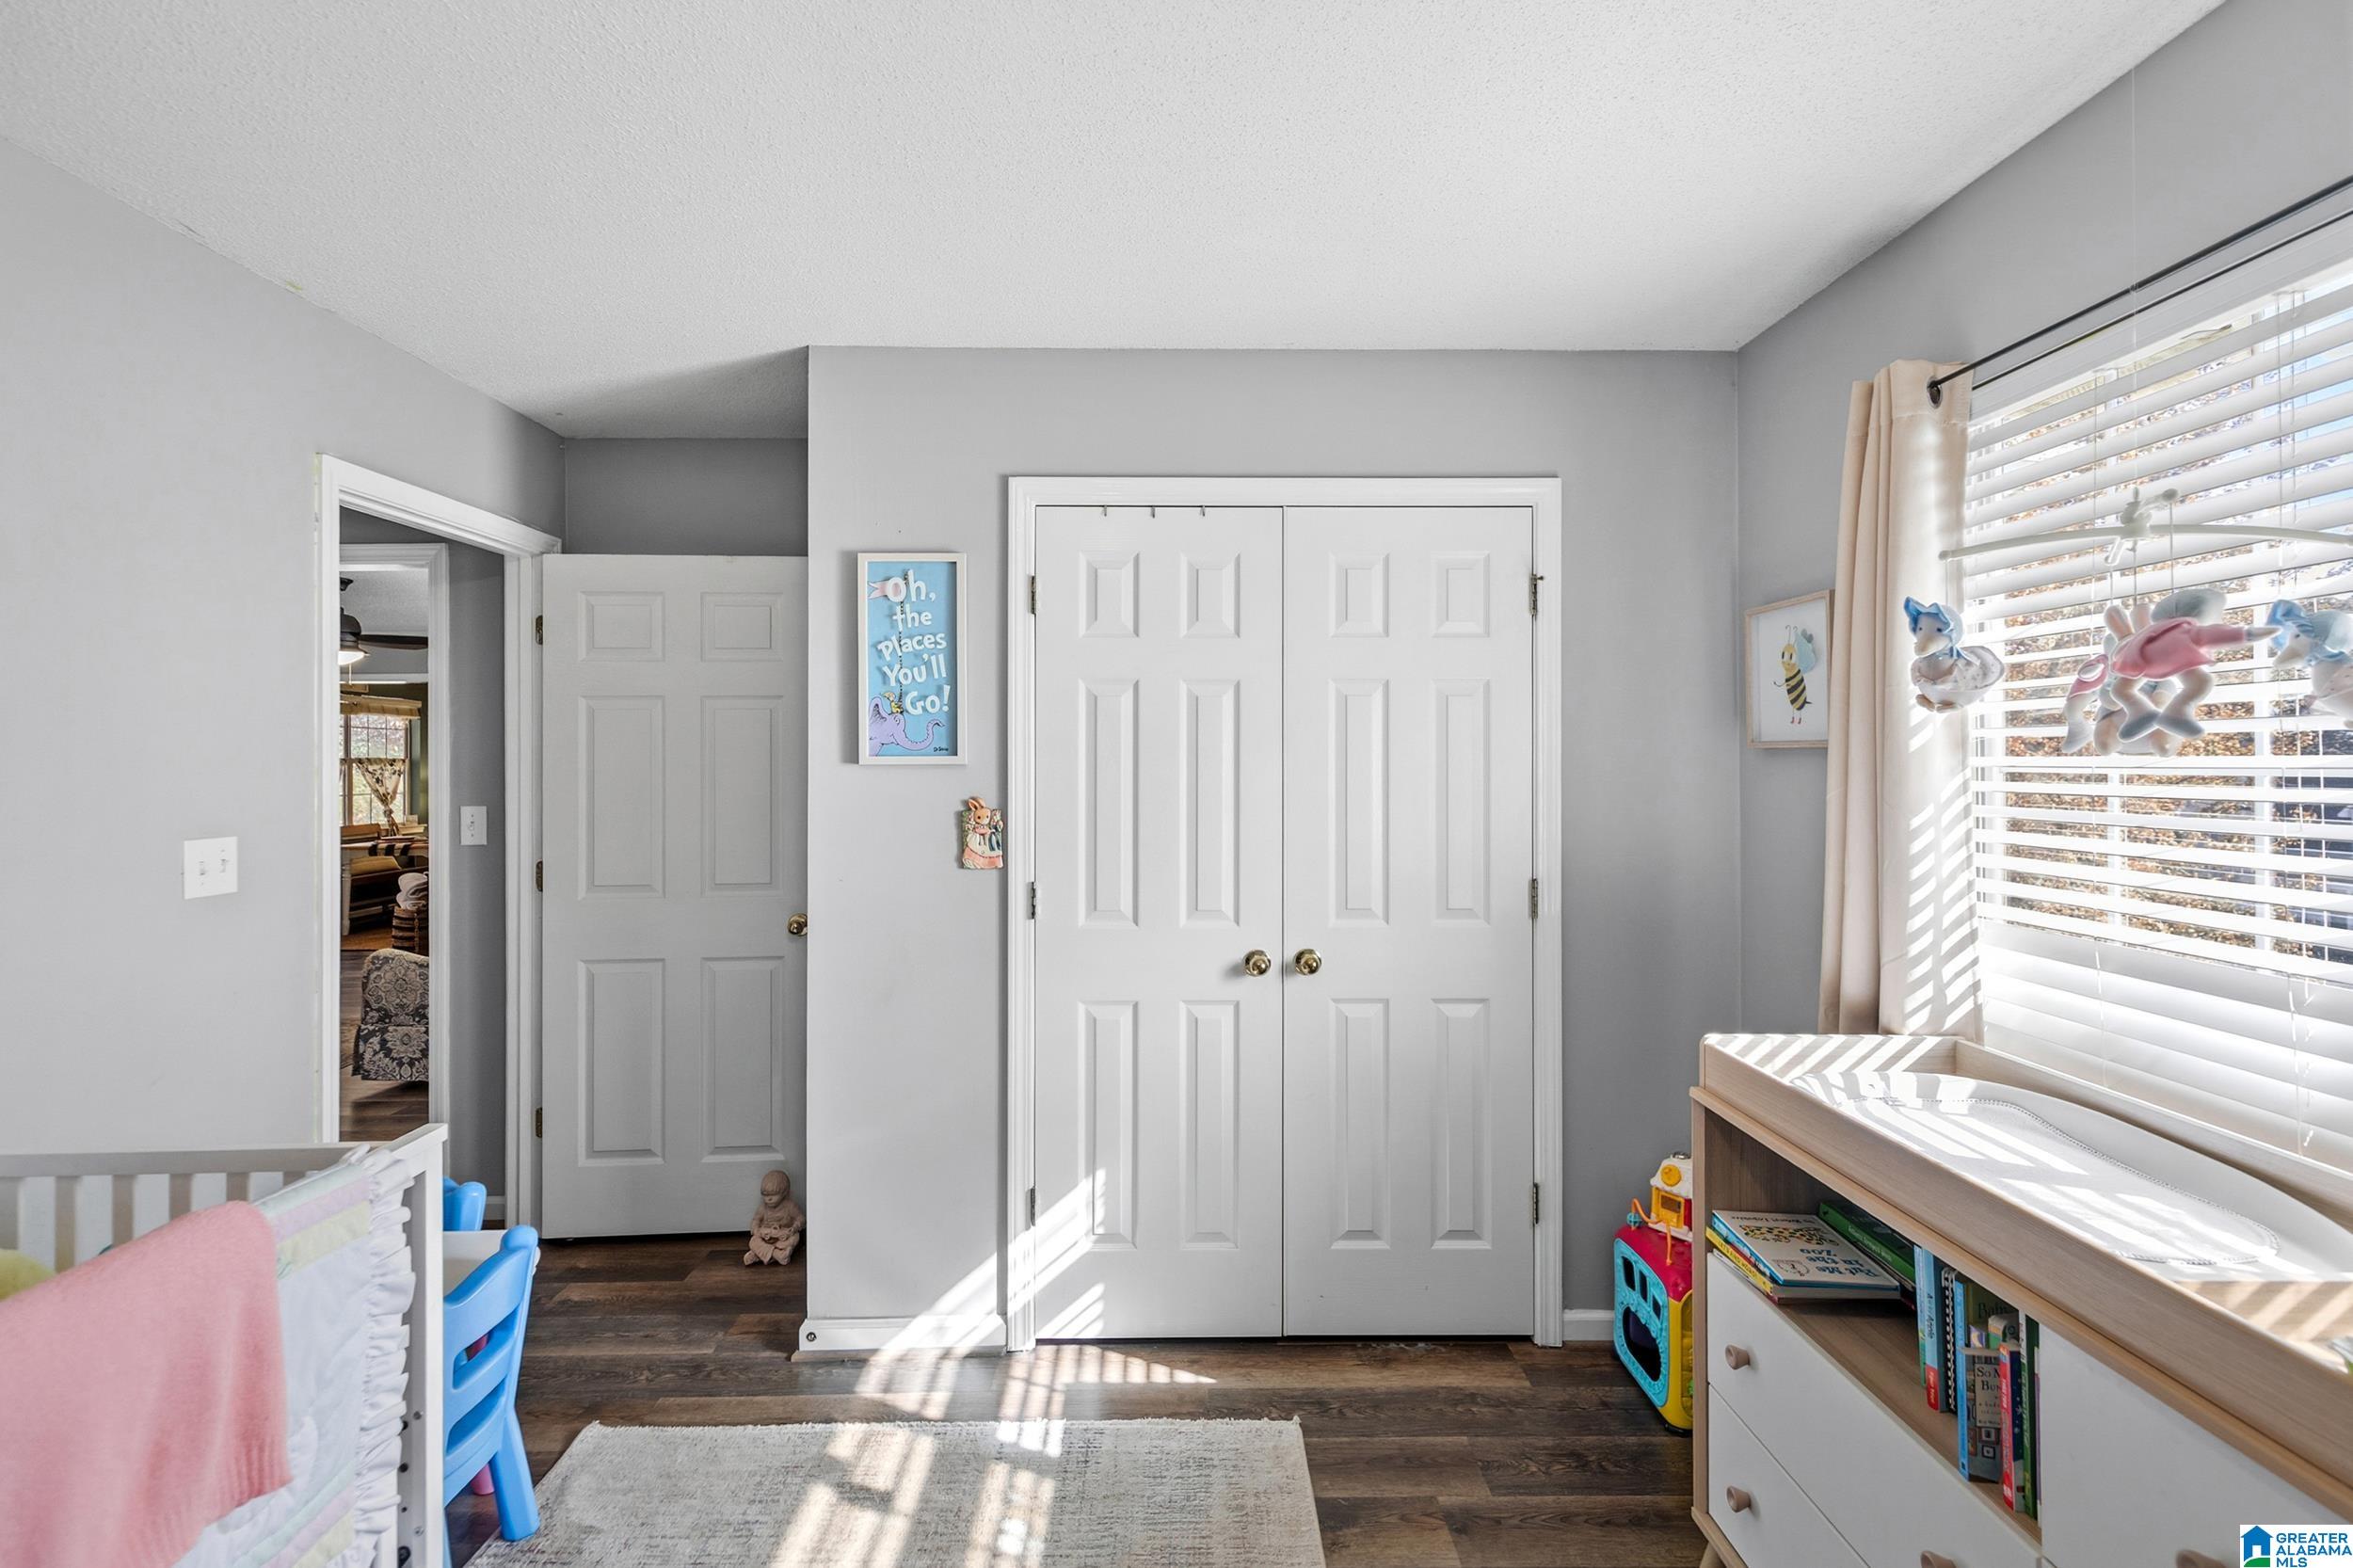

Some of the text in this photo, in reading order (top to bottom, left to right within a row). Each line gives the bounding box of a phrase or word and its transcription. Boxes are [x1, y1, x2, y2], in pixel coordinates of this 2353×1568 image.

[887, 568, 936, 602] Oh,
[892, 603, 933, 631] the
[877, 632, 947, 661] Places
[882, 653, 947, 687] You'll
[904, 684, 951, 715] Go!
[1800, 1248, 1833, 1256] Zoo
[1806, 1256, 1838, 1264] the
[1845, 1266, 1881, 1278] Put
